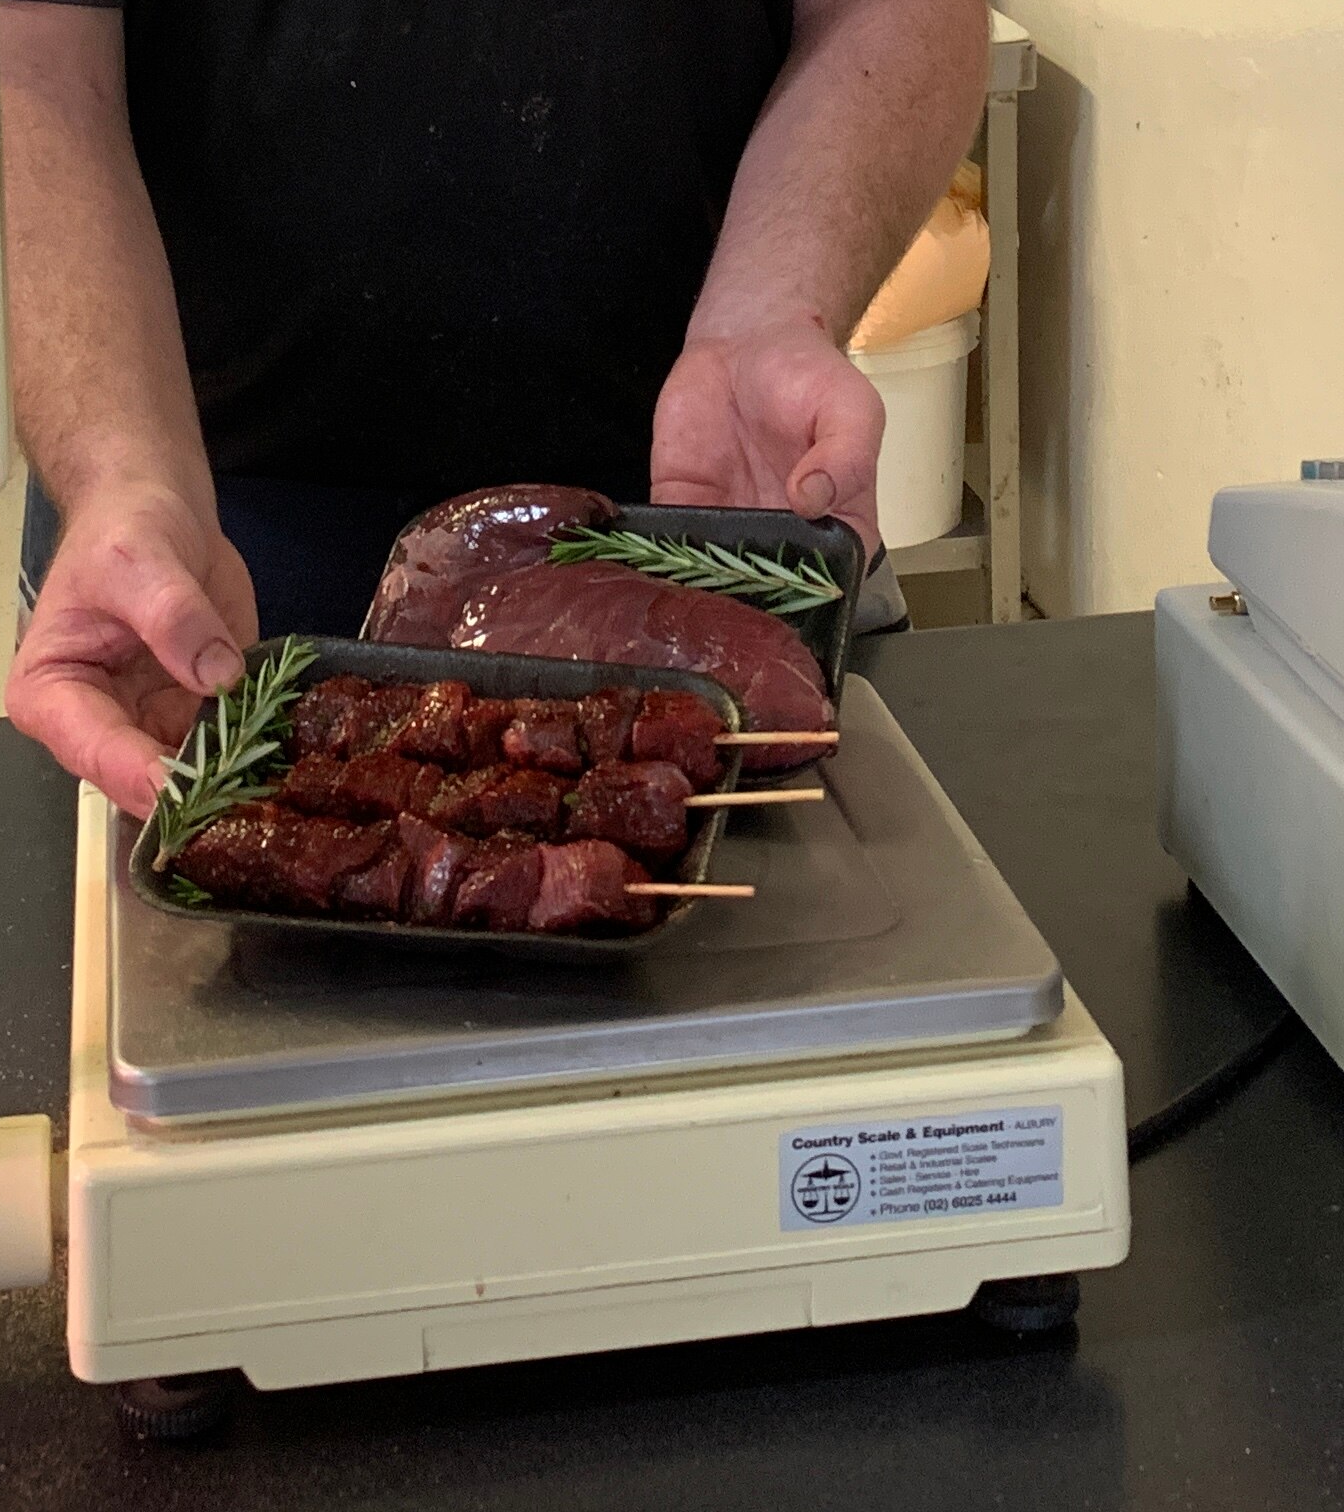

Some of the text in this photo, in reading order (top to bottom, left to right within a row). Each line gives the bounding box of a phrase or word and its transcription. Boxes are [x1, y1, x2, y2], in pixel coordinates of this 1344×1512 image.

[792, 1135, 852, 1150] Country
[858, 1130, 900, 1144] Scale
[906, 1128, 917, 1139] &
[923, 1120, 1005, 1139] Equipment
[880, 1191, 1017, 1216] Phone (02) 6025 4444
